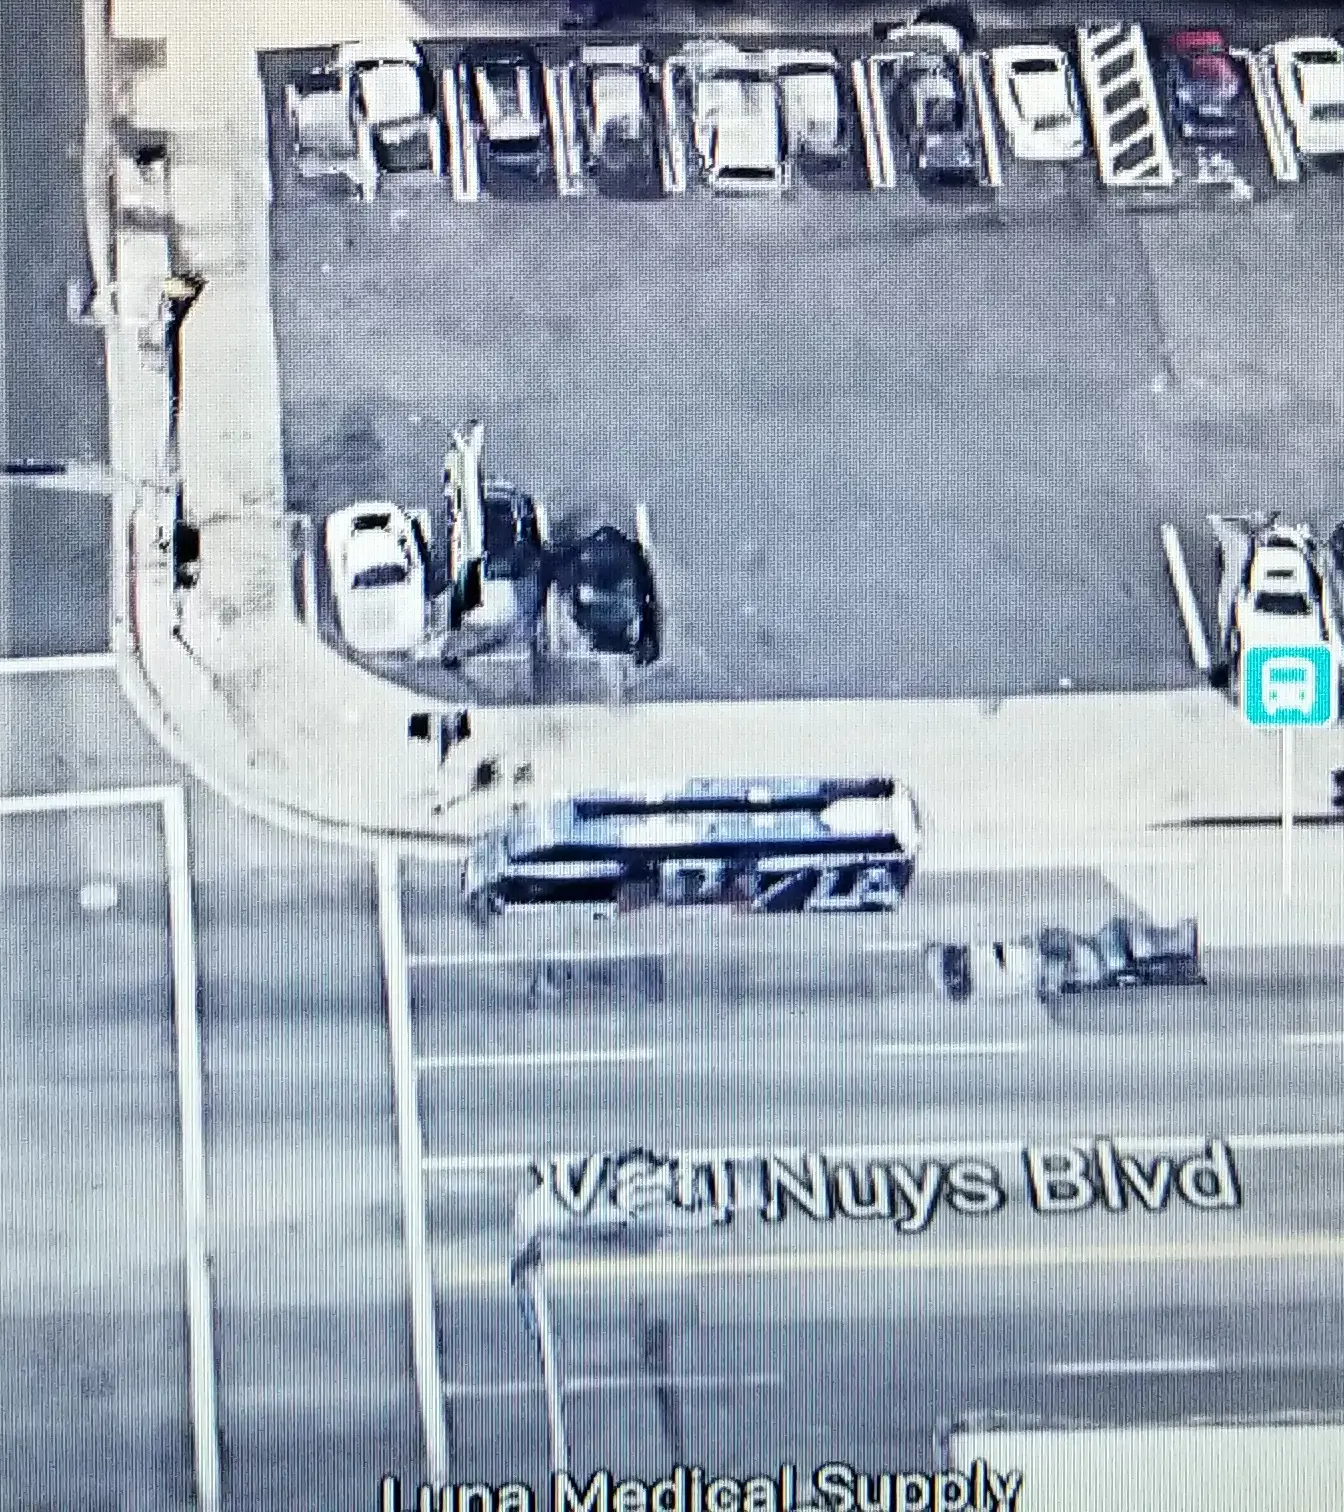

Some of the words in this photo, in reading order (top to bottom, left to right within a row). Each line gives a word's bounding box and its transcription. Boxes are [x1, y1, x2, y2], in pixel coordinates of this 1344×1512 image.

[762, 1152, 1007, 1230] Nuys
[1027, 1138, 1242, 1212] Blvd
[552, 1464, 797, 1512] Medical
[813, 1457, 1023, 1512] Supply
